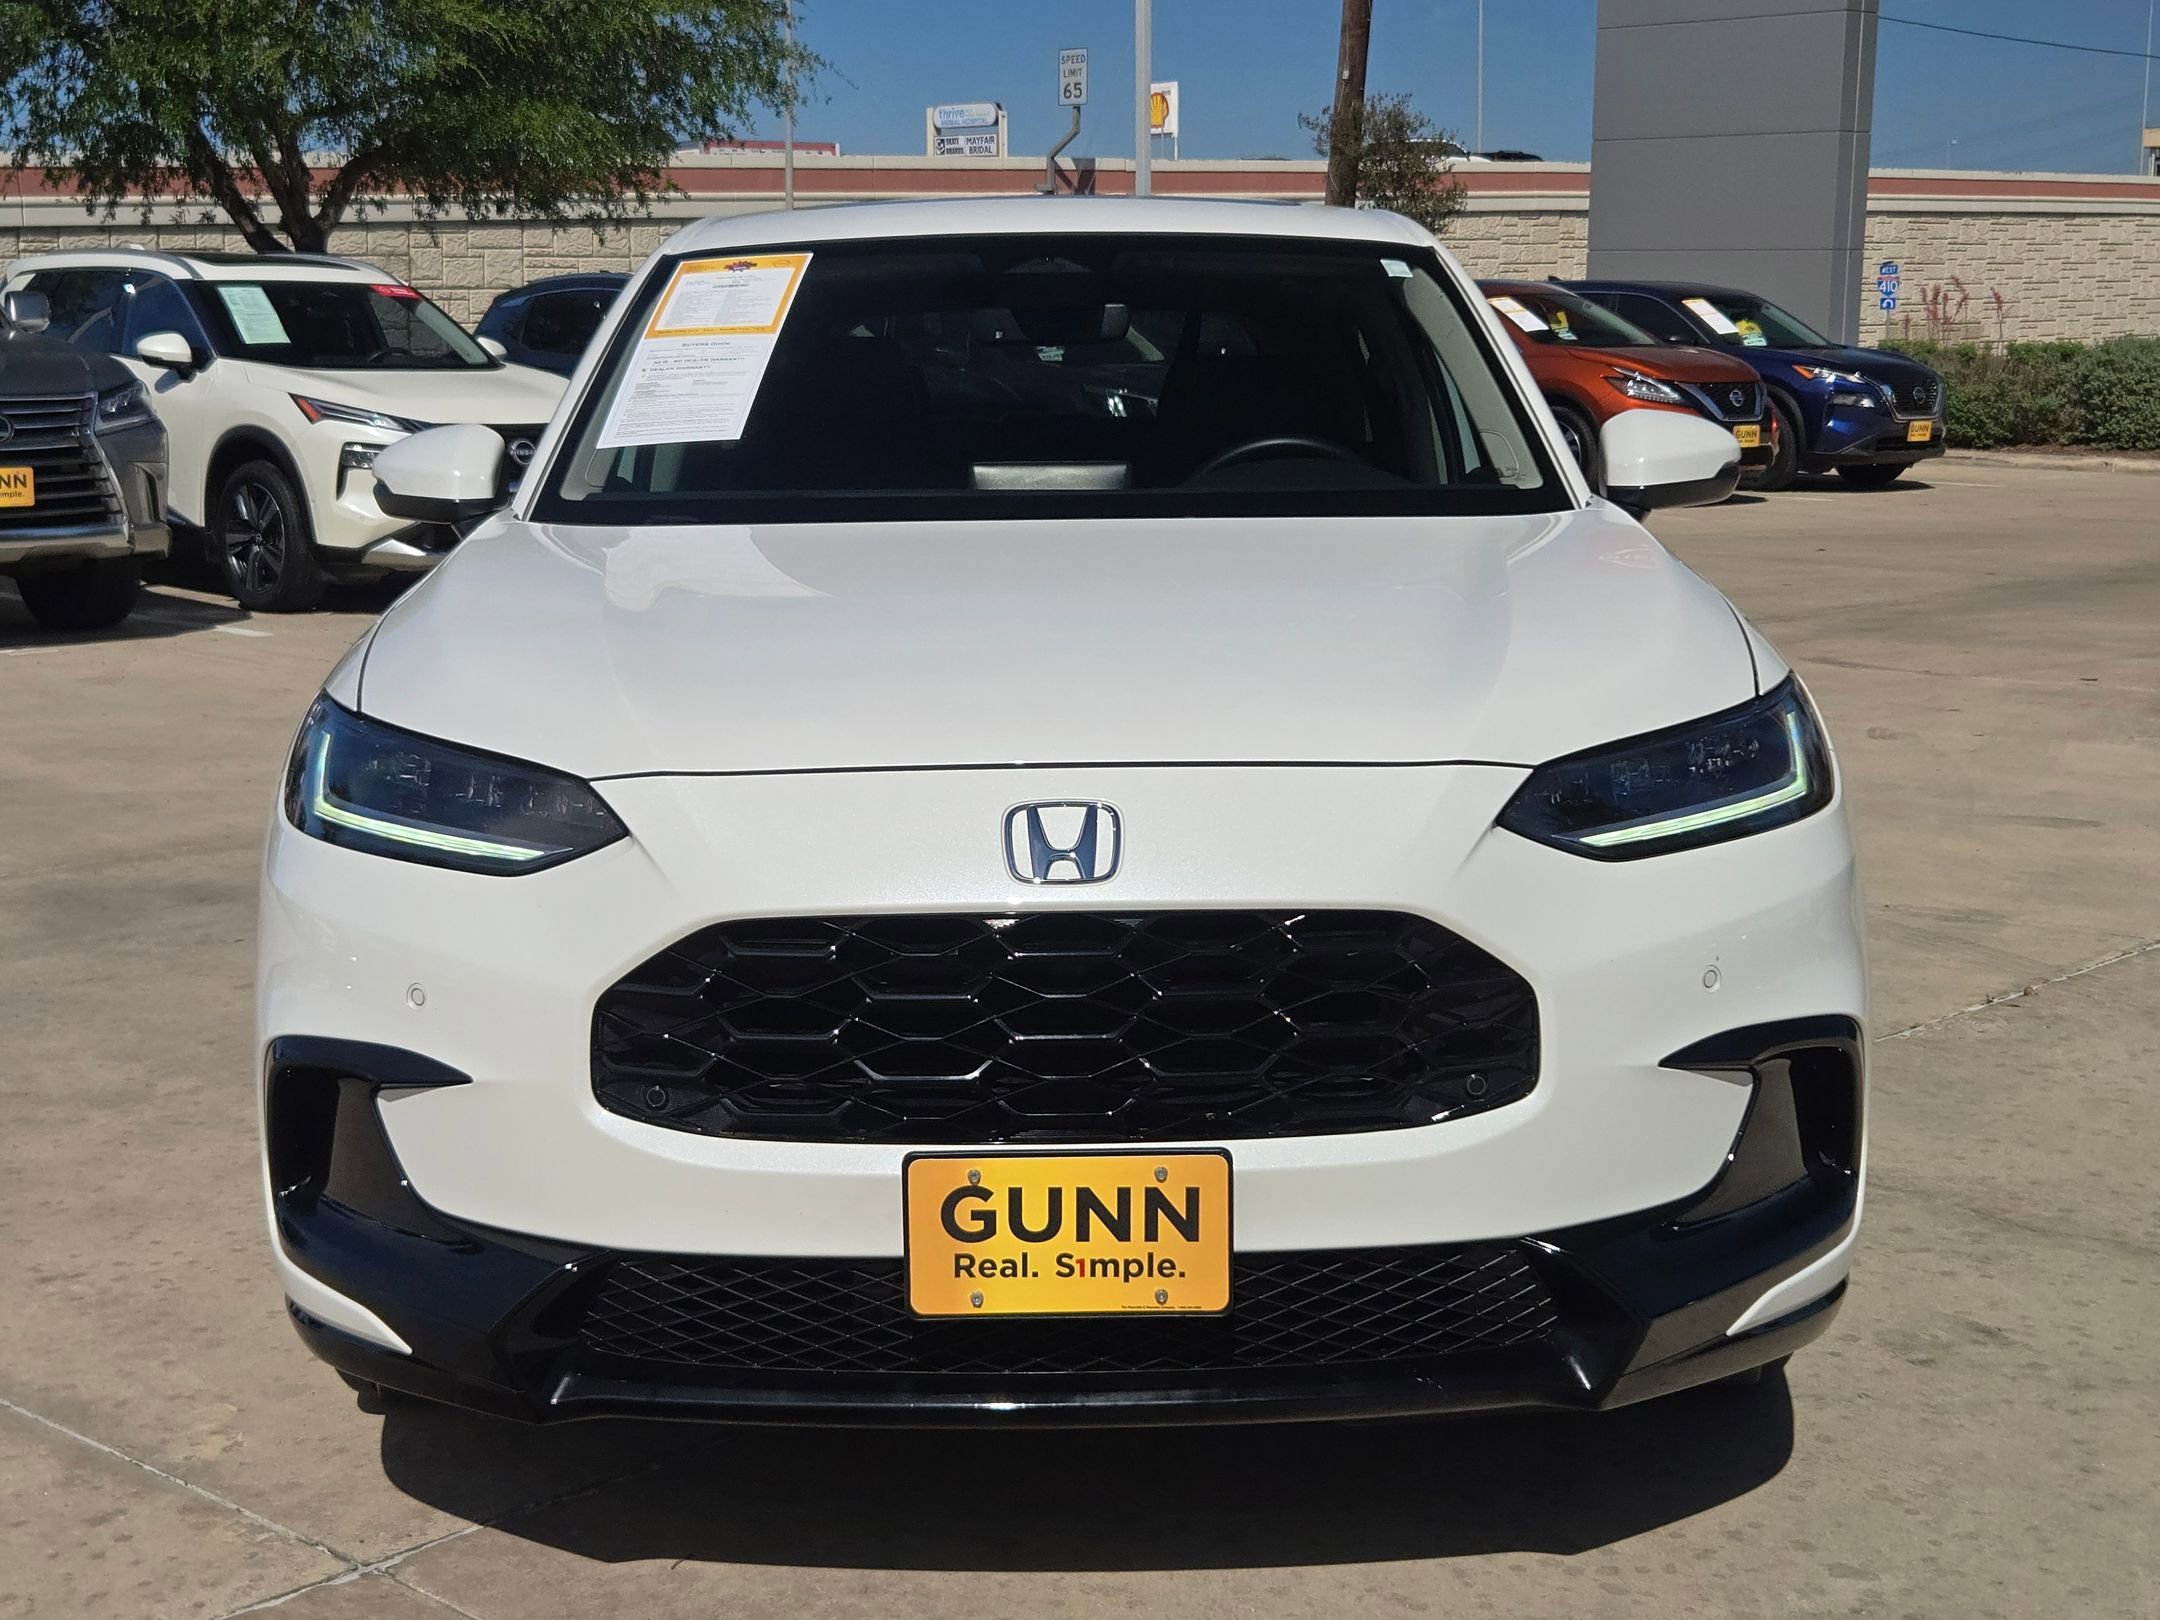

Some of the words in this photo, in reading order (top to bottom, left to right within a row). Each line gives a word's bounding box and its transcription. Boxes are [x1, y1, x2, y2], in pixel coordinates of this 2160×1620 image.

[1061, 54, 1086, 64] SPEED
[1063, 68, 1082, 78] LIMIT
[1063, 82, 1082, 99] 65
[939, 109, 965, 119] thrive
[966, 136, 995, 145] MAYFAIR
[969, 146, 993, 154] BRIDAL
[1879, 281, 1897, 292] 410
[1735, 430, 1758, 438] GUNN
[941, 1185, 1200, 1243] GUNN
[954, 1252, 1038, 1278] Real.
[1056, 1252, 1186, 1283] S1mple.
